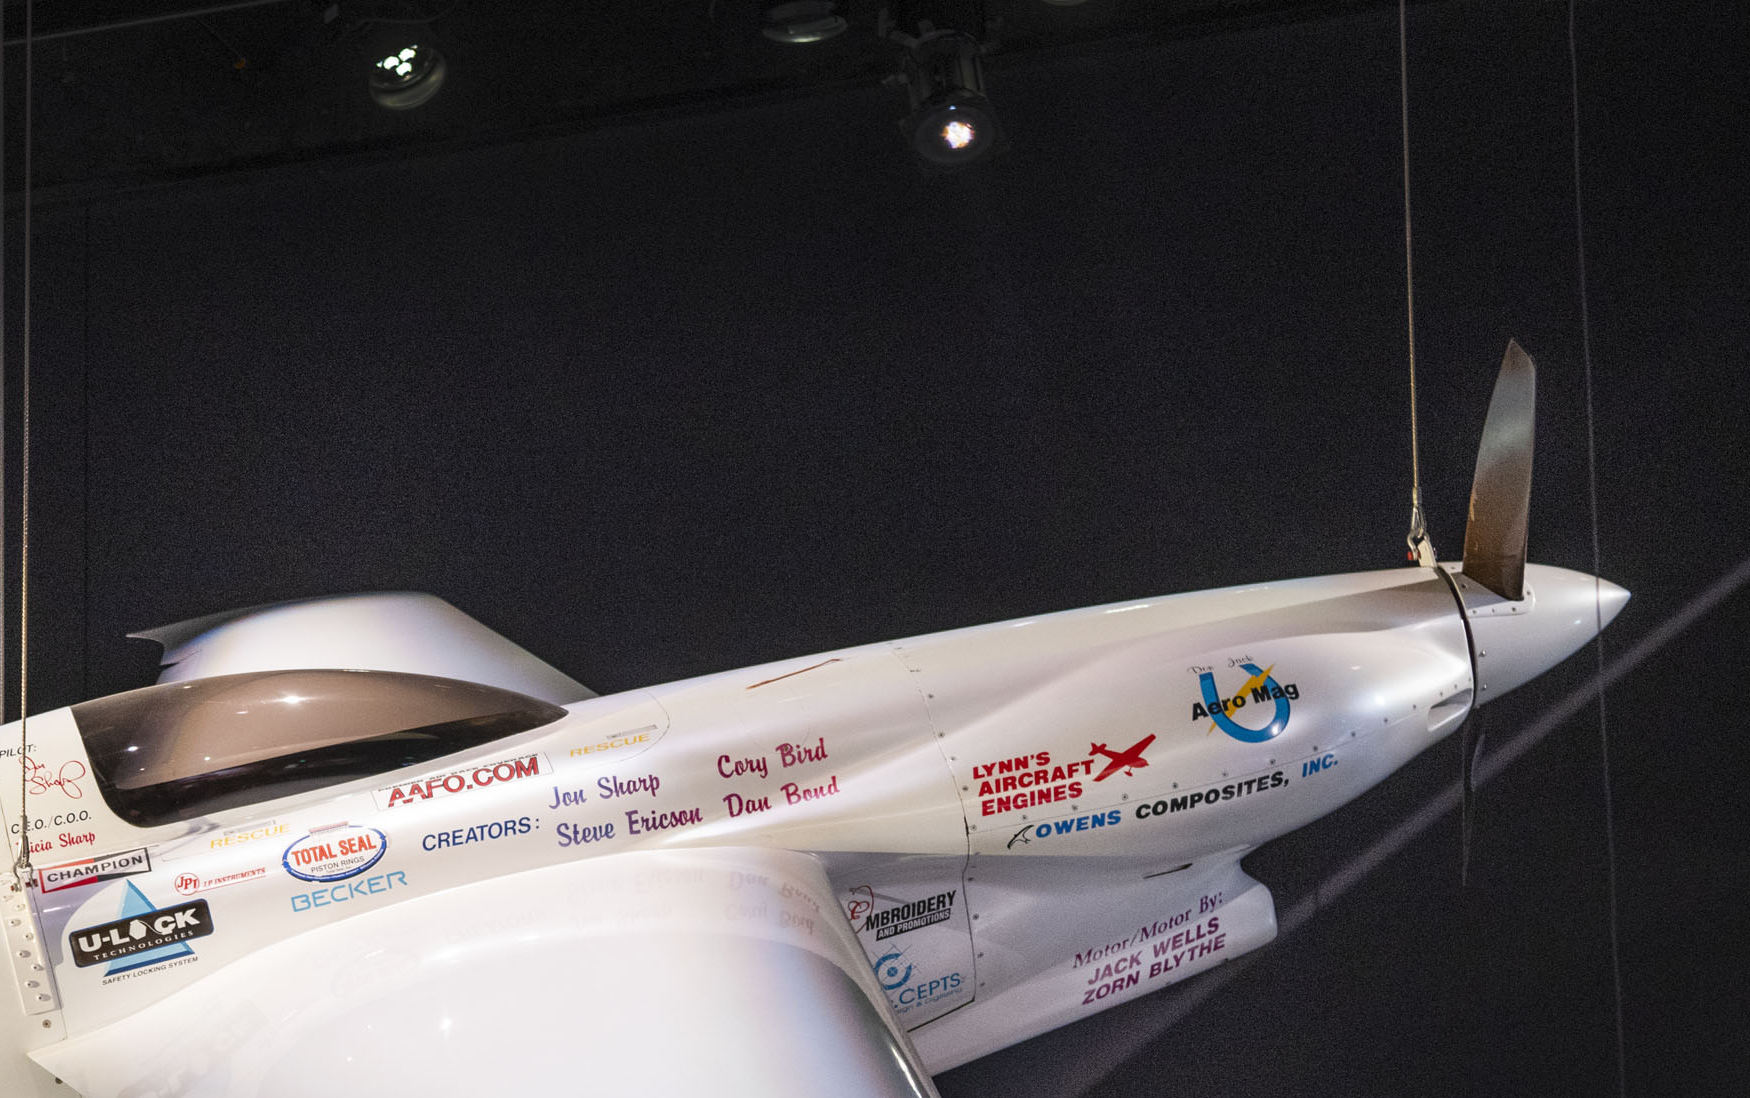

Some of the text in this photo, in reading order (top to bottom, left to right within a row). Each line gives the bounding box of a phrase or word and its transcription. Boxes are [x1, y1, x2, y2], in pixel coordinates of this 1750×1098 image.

[1192, 683, 1300, 721] Aero Mag
[570, 733, 651, 757] RESCUE
[717, 737, 828, 779] Cory Bird
[388, 756, 539, 808] AAFO.COM
[972, 751, 1051, 780] LYNN'S
[977, 759, 1095, 797] AIRCRAFT
[549, 774, 661, 810] Jon Sharp
[723, 775, 841, 818] Dan Bond
[981, 781, 1083, 817] ENGINES
[1035, 753, 1339, 839] OWENS COMPOSITES, INC.
[58, 831, 96, 848] Sharp
[210, 823, 291, 849] RESCUE
[422, 816, 540, 852] CREATORS:
[556, 807, 704, 848] Steve Ericson
[291, 843, 338, 867] TOTAL
[338, 834, 377, 856] SEAL
[310, 861, 339, 873] PISTON
[340, 855, 365, 867] RINGS
[47, 855, 143, 883] CHAMPION
[291, 870, 408, 913] BECKER
[878, 910, 950, 939] AND PROMOTIONS
[92, 930, 194, 961] TECHNOLOGIES
[1087, 916, 1221, 986] JACK WELLS
[101, 955, 199, 986] SAFETY LOCKING SYSTEM
[1081, 933, 1227, 1006] ZORN BLYTHE
